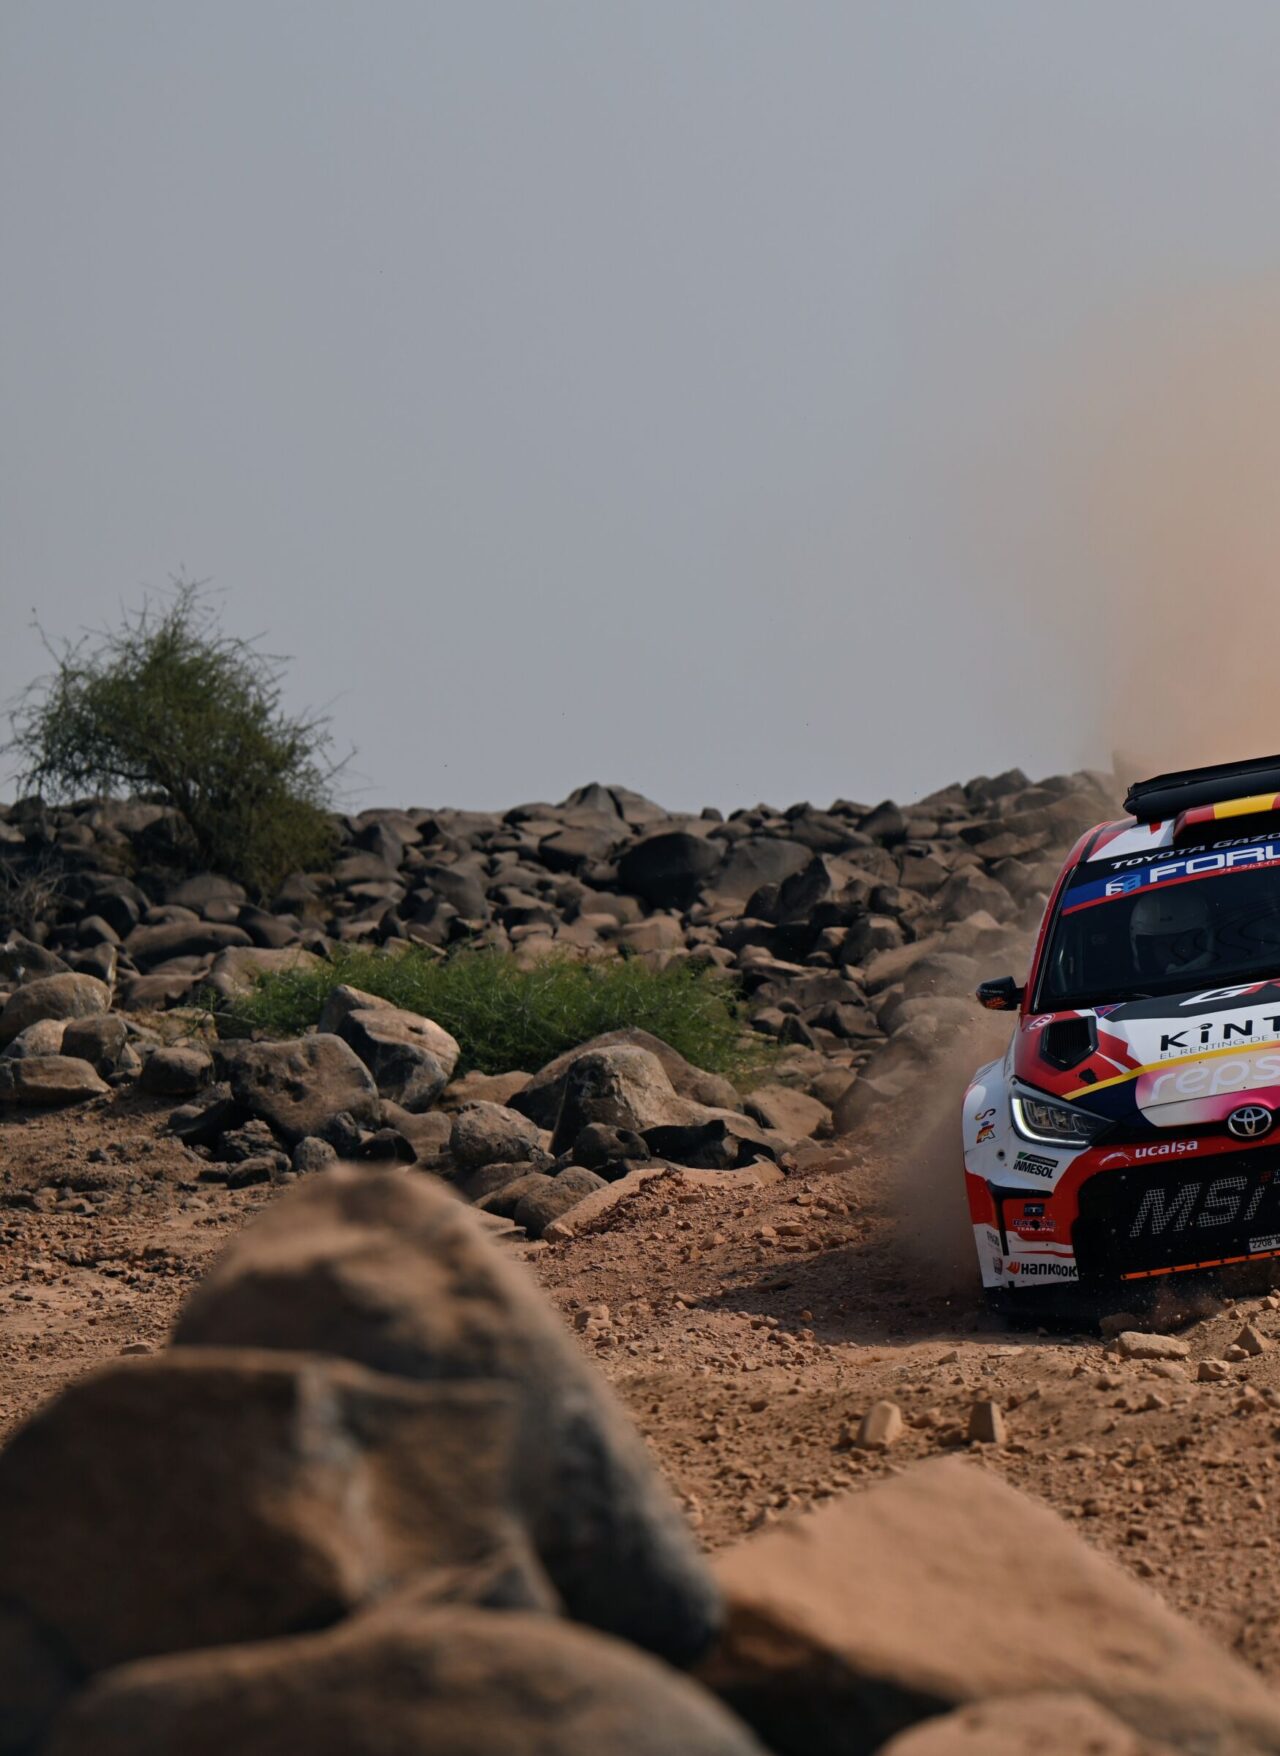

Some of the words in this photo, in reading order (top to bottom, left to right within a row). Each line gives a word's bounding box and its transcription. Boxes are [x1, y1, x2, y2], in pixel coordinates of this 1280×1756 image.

[1111, 845, 1205, 870] TOYOTA
[1160, 1052, 1174, 1060] EL
[1180, 1038, 1245, 1055] RENTING
[1251, 1034, 1269, 1043] DE
[1135, 1139, 1198, 1158] ucalsa
